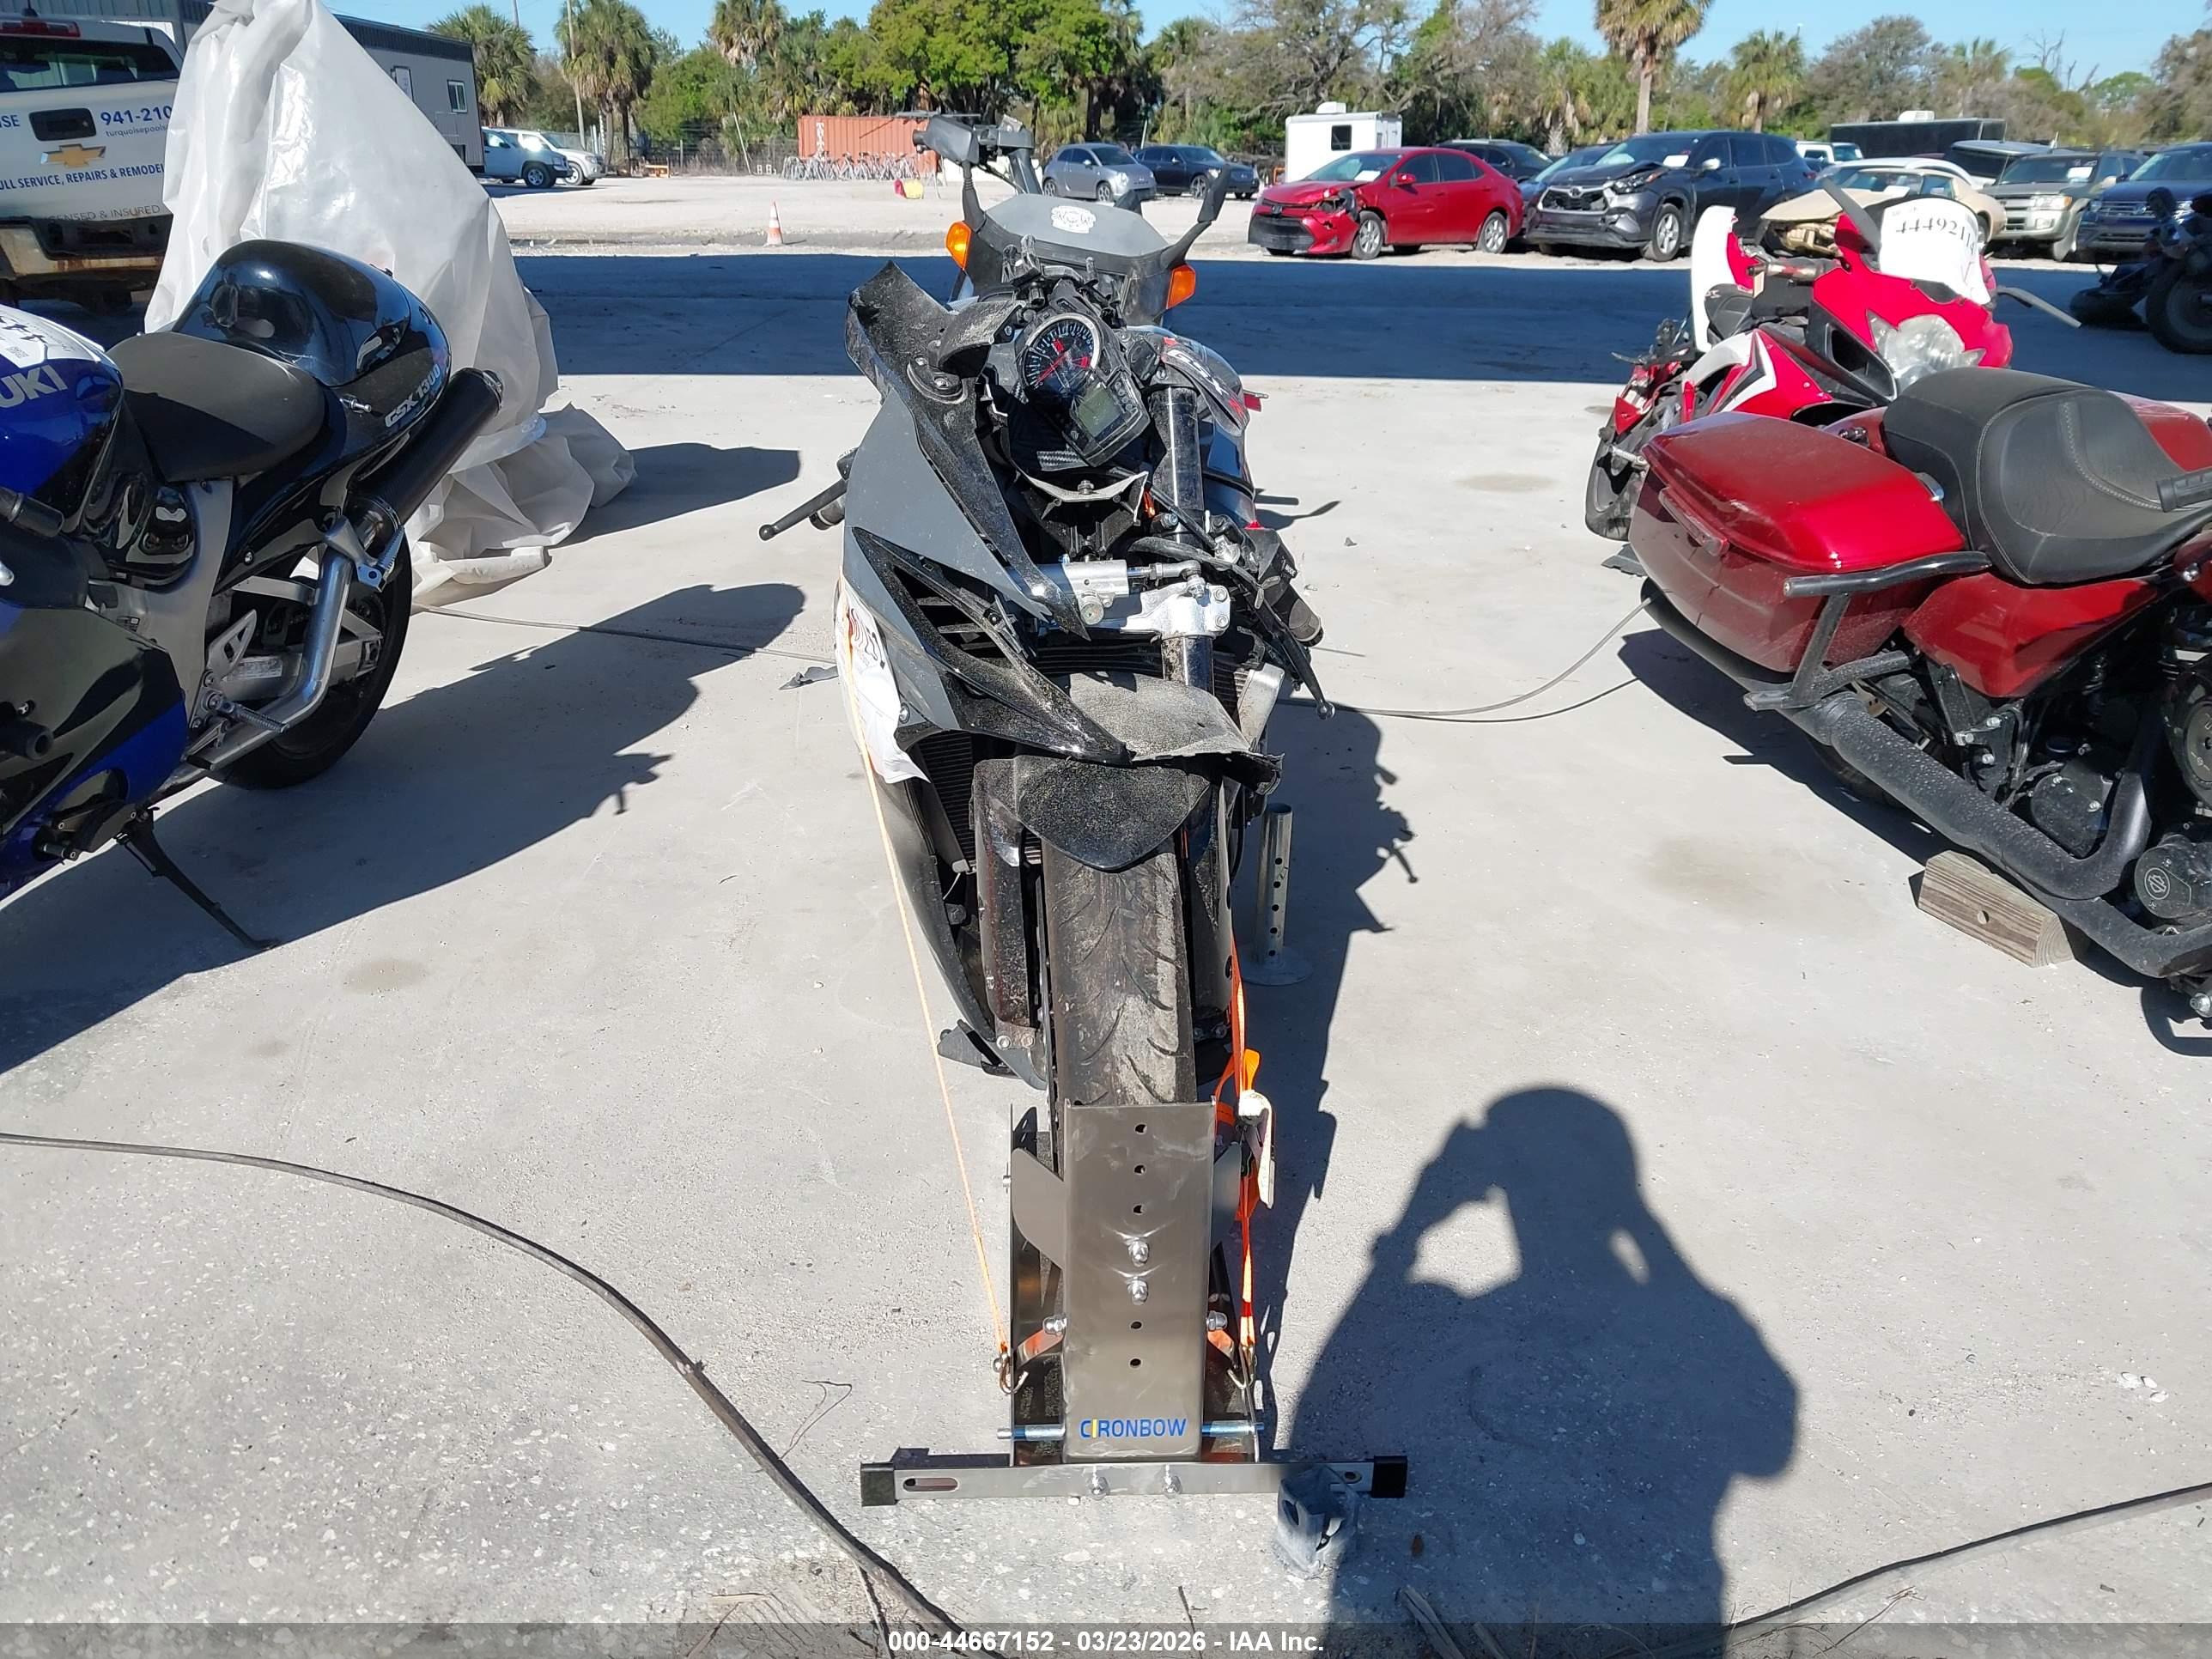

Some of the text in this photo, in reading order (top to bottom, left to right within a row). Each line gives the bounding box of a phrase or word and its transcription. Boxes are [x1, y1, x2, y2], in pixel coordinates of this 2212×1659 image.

[0, 114, 21, 128] SE
[100, 106, 172, 125] 941-210
[17, 173, 64, 188] SERVICE,
[66, 169, 107, 183] REPAIRS
[110, 168, 118, 178] &
[99, 210, 107, 219] &
[110, 204, 161, 218] INSURED
[385, 363, 441, 428] GSX 1300
